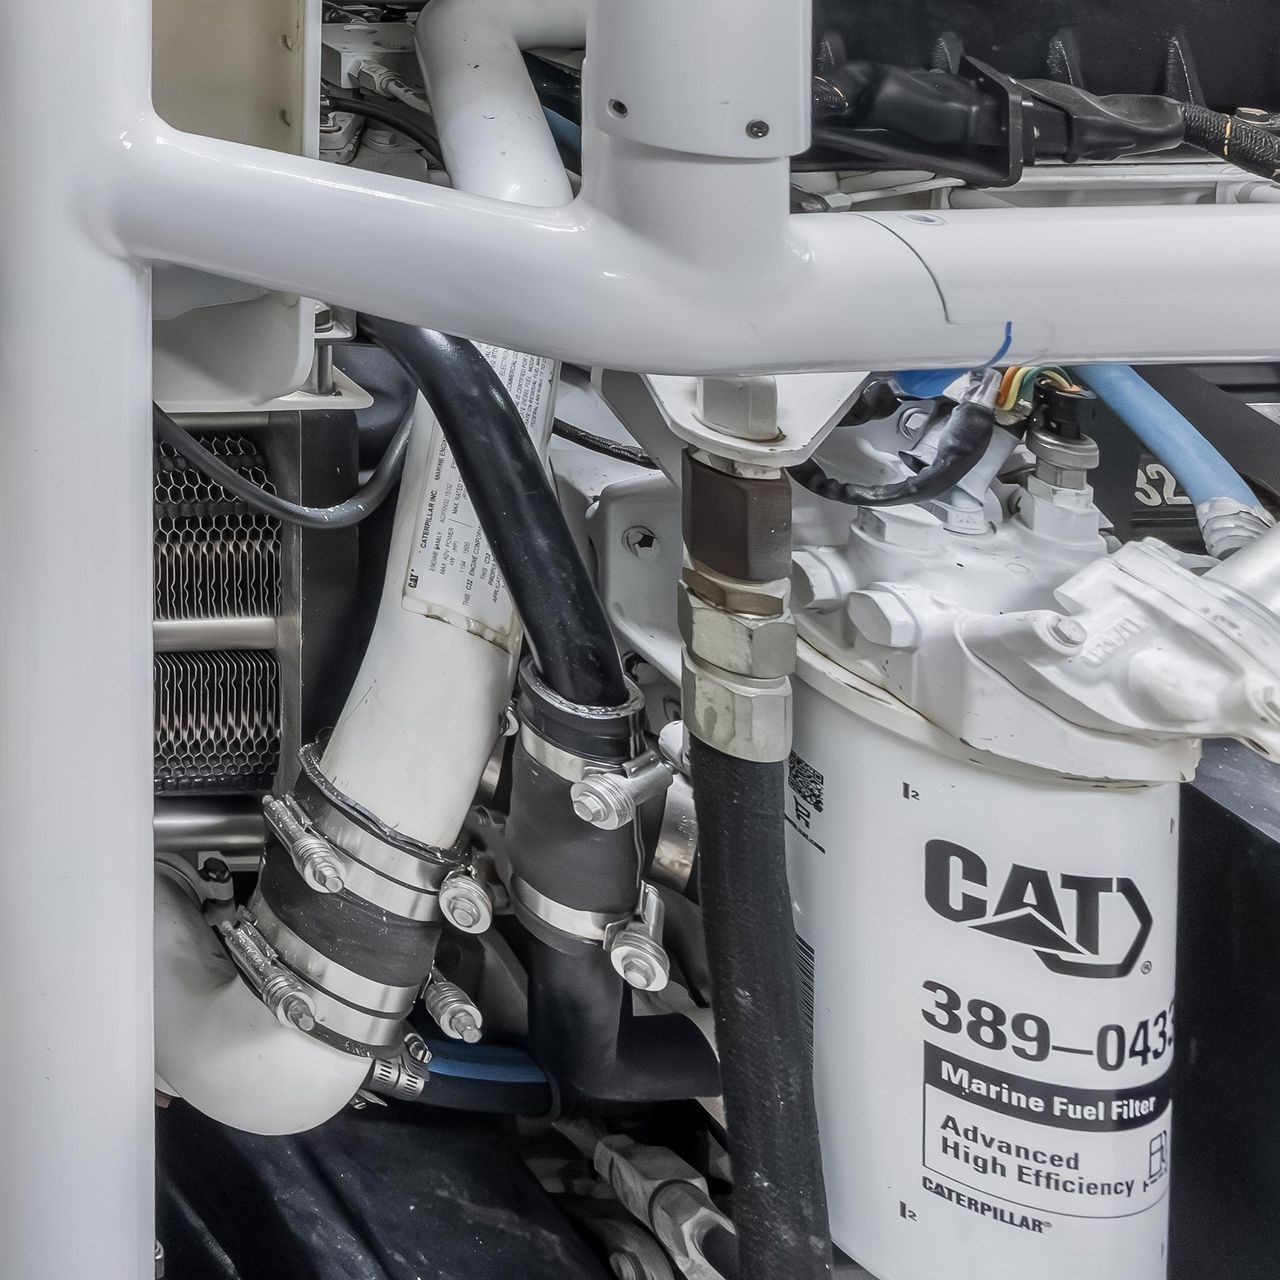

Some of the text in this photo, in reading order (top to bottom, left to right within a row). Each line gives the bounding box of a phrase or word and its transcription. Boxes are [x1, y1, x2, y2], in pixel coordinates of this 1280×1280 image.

[420, 502, 434, 549] CATERPILLAR
[408, 574, 418, 588] CAT
[465, 579, 473, 590] C32
[468, 555, 478, 576] ENGINE
[923, 839, 1114, 957] CAT
[941, 1060, 1157, 1121] Marine Fuel Filter
[940, 1114, 1080, 1171] Advanced
[941, 1136, 1136, 1197] High Efficiency
[922, 1176, 1045, 1234] CATERPILLAR
